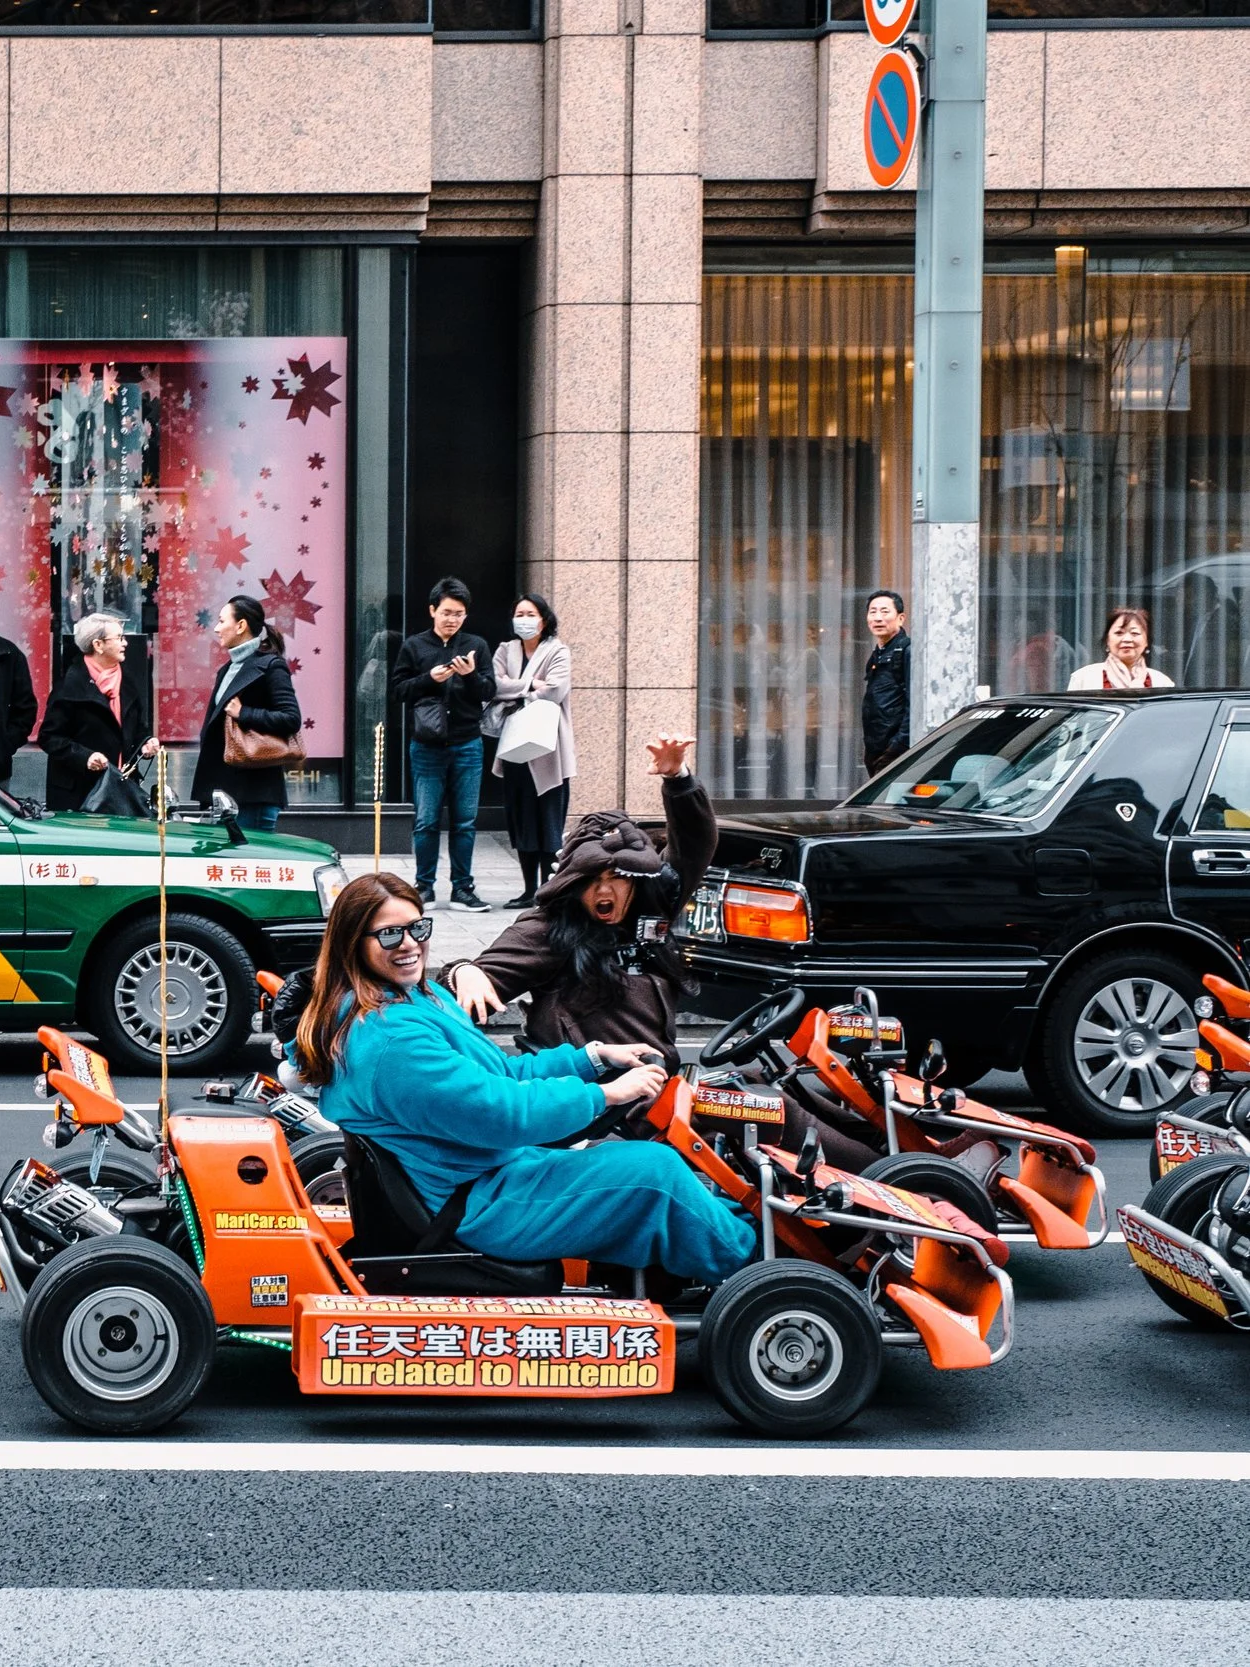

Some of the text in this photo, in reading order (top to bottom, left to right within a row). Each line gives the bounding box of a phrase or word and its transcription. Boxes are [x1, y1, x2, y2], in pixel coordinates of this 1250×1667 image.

[207, 865, 294, 883] 東京無線
[215, 1213, 309, 1229] MariCar.com
[321, 1323, 661, 1359] 任天堂は無関係
[321, 1358, 659, 1388] Unrelated to Nintendo
